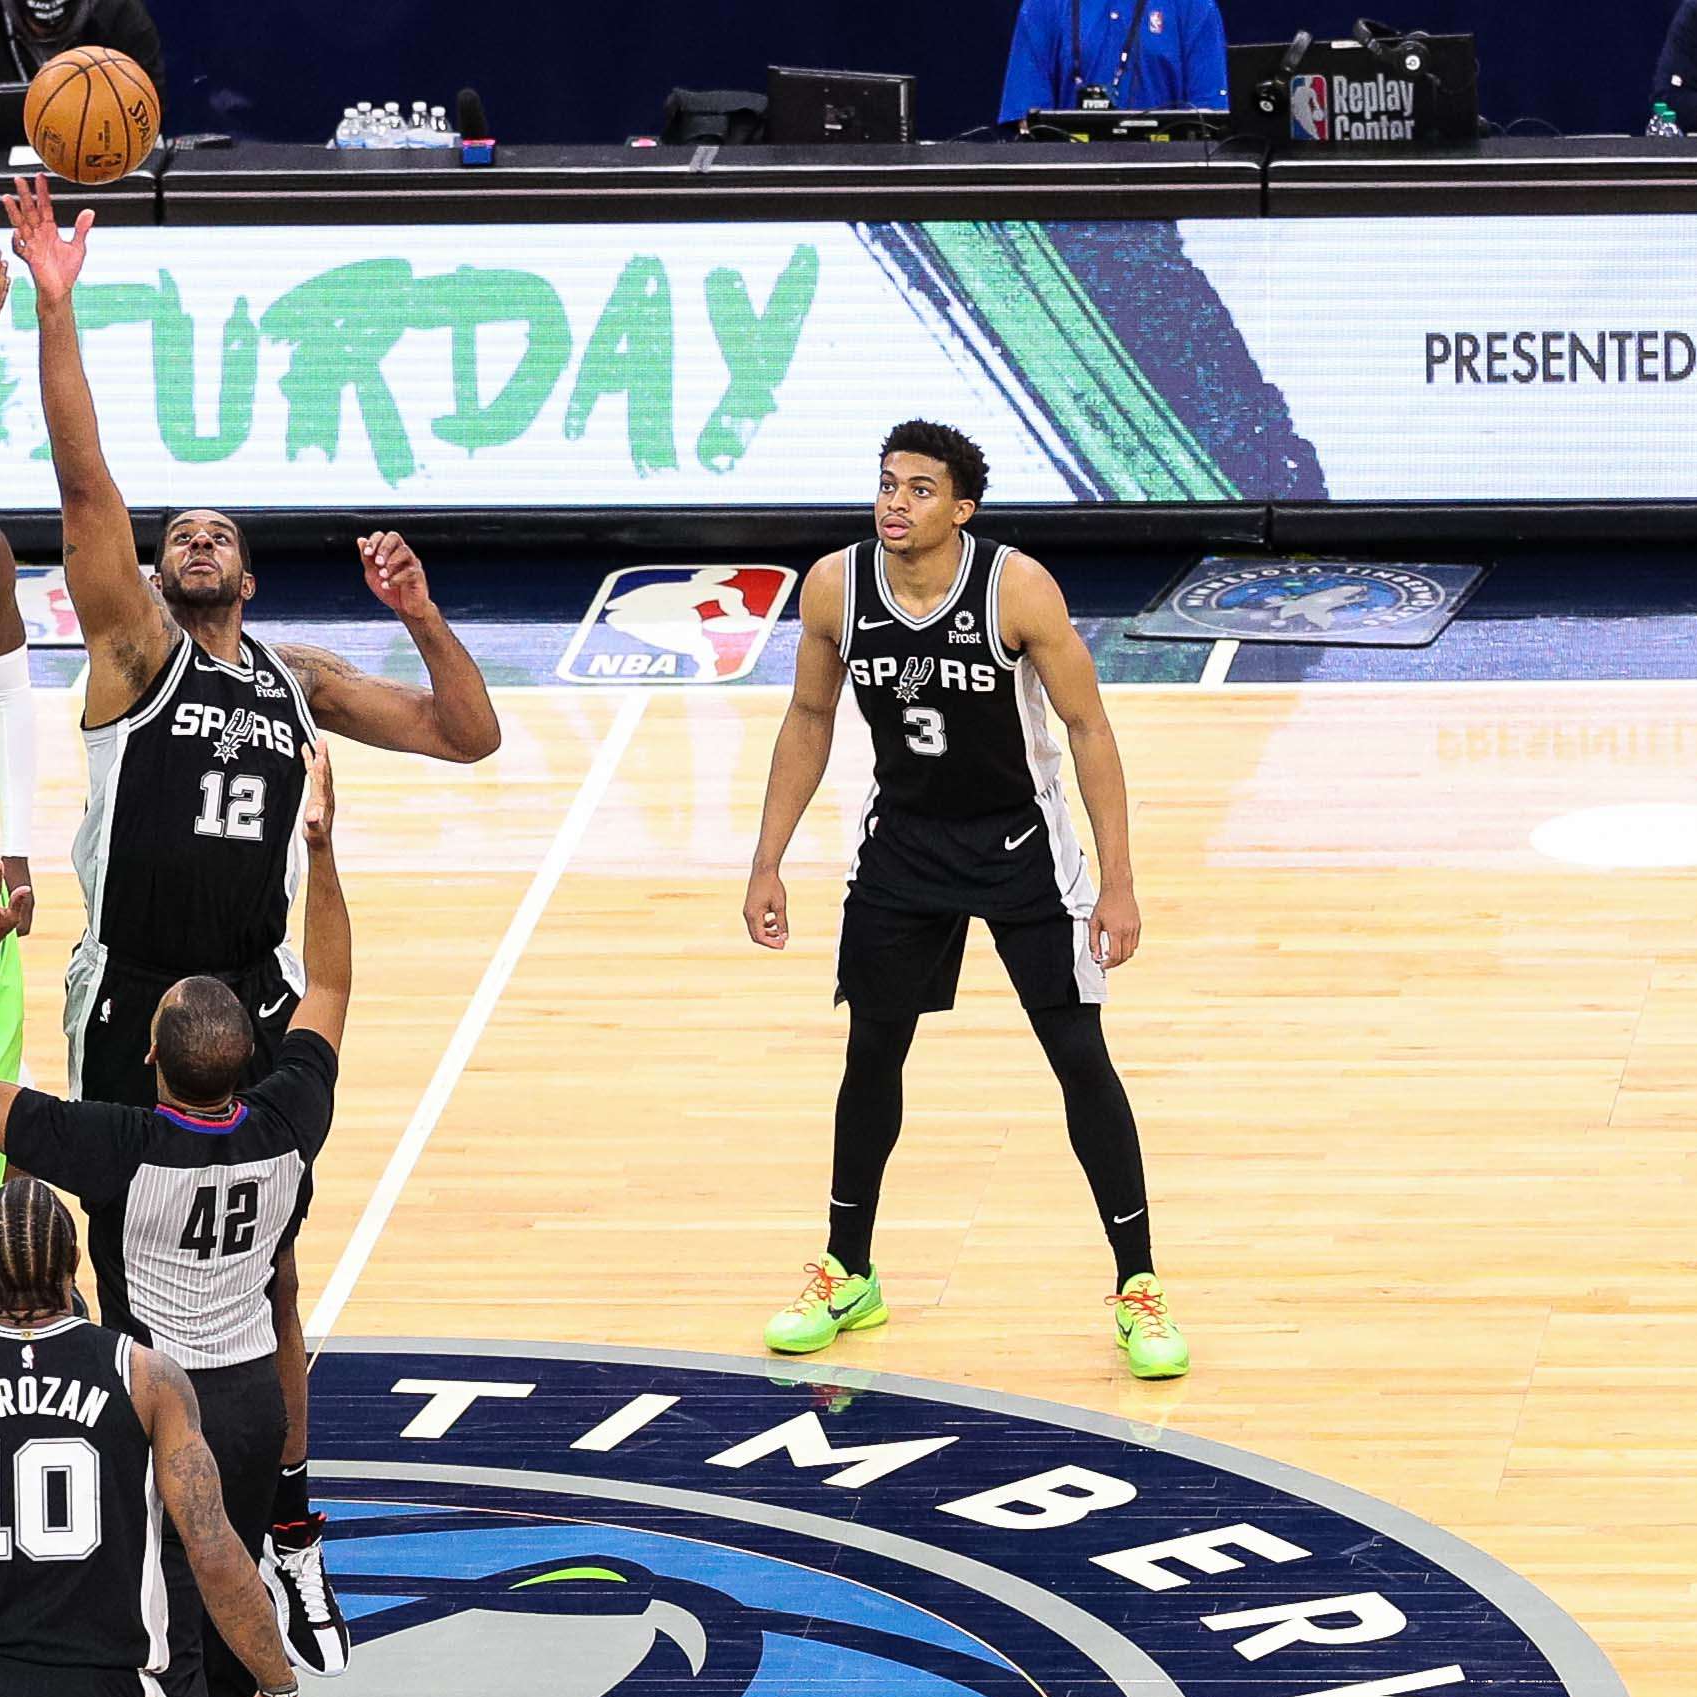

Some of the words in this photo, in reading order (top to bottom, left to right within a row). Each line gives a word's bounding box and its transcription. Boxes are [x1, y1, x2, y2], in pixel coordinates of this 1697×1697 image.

[1332, 73, 1415, 120] Replay
[1334, 115, 1416, 141] Center
[1424, 330, 1697, 384] PRESENTED
[947, 630, 982, 645] Frost
[587, 654, 679, 676] NBA
[848, 656, 996, 704] SPURS
[254, 684, 288, 699] Frost
[170, 702, 295, 765] SPURS
[902, 705, 948, 758] 3
[193, 770, 267, 842] 12
[179, 1180, 259, 1261] 42
